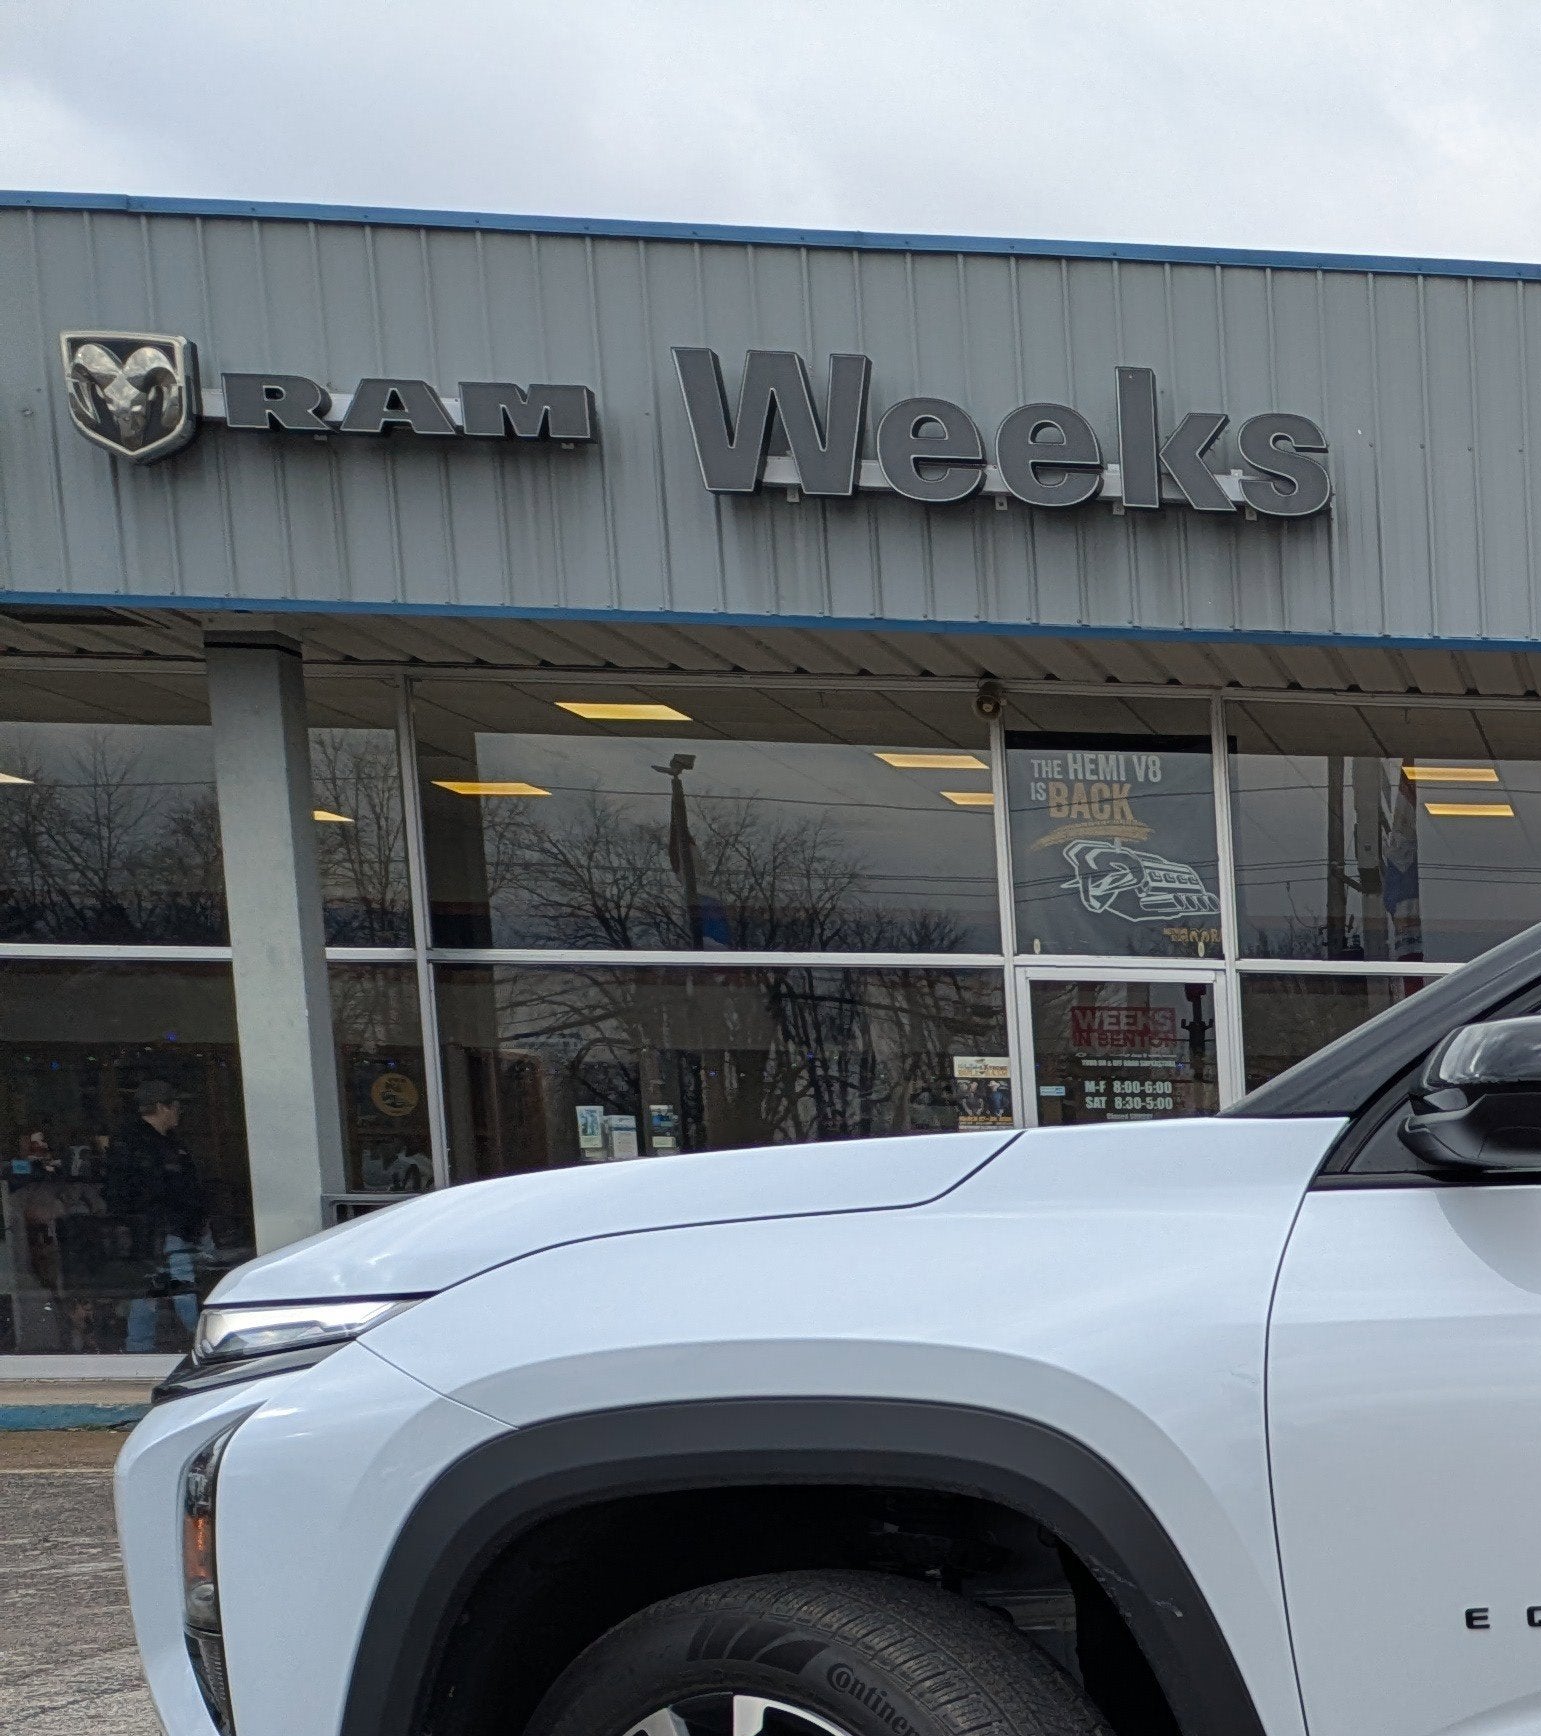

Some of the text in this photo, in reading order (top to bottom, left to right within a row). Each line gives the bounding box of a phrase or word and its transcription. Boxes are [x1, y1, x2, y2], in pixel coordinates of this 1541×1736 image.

[221, 371, 597, 444] RAM
[669, 346, 1333, 518] Weeks
[1031, 753, 1162, 782] THE HEMI V8
[1030, 782, 1135, 820] IS BACK
[1075, 1010, 1173, 1031] WEEKS
[1084, 1081, 1172, 1094] M-F 8:00-6:00
[1085, 1097, 1173, 1110] SAT 8:30-5:00
